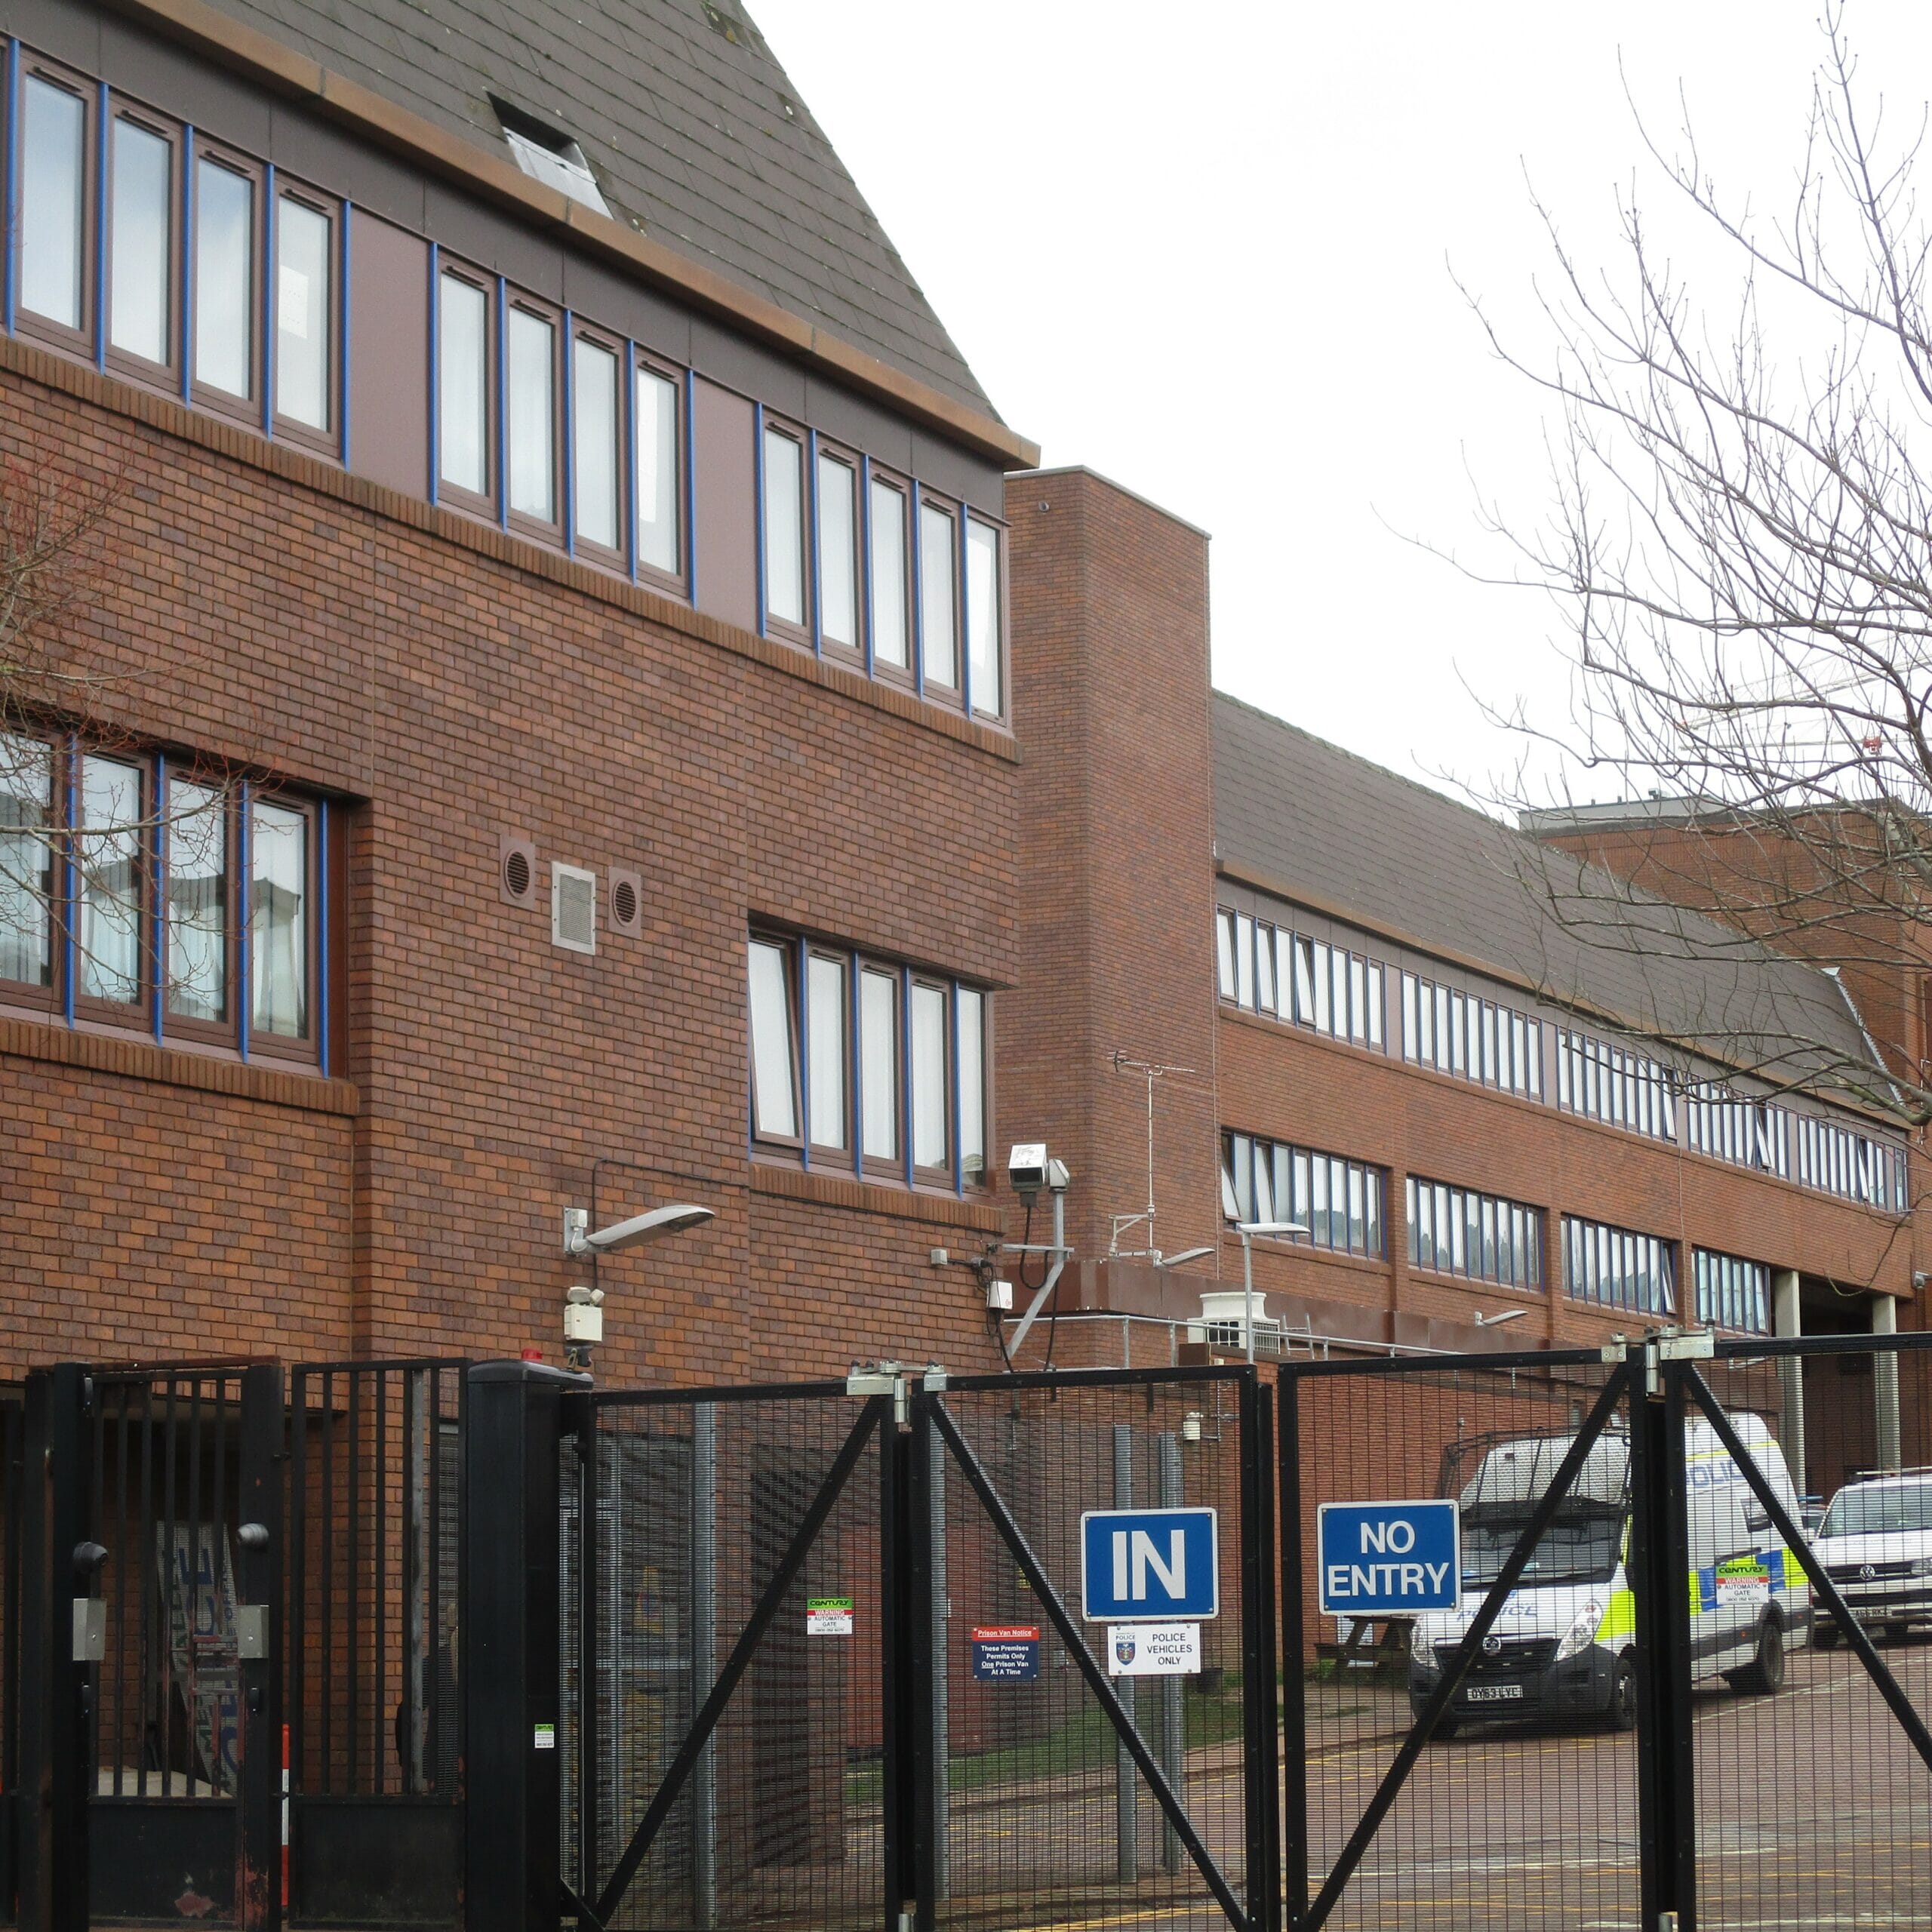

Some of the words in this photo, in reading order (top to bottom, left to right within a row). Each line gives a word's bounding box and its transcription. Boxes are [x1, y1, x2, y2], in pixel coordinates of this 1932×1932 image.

[1360, 1520, 1416, 1554] NO
[1112, 1529, 1186, 1601] IN
[1327, 1562, 1450, 1597] ENTRY
[1152, 1632, 1186, 1642] POLICE
[1146, 1644, 1193, 1654] VEHICLES
[1158, 1657, 1181, 1666] ONLY
